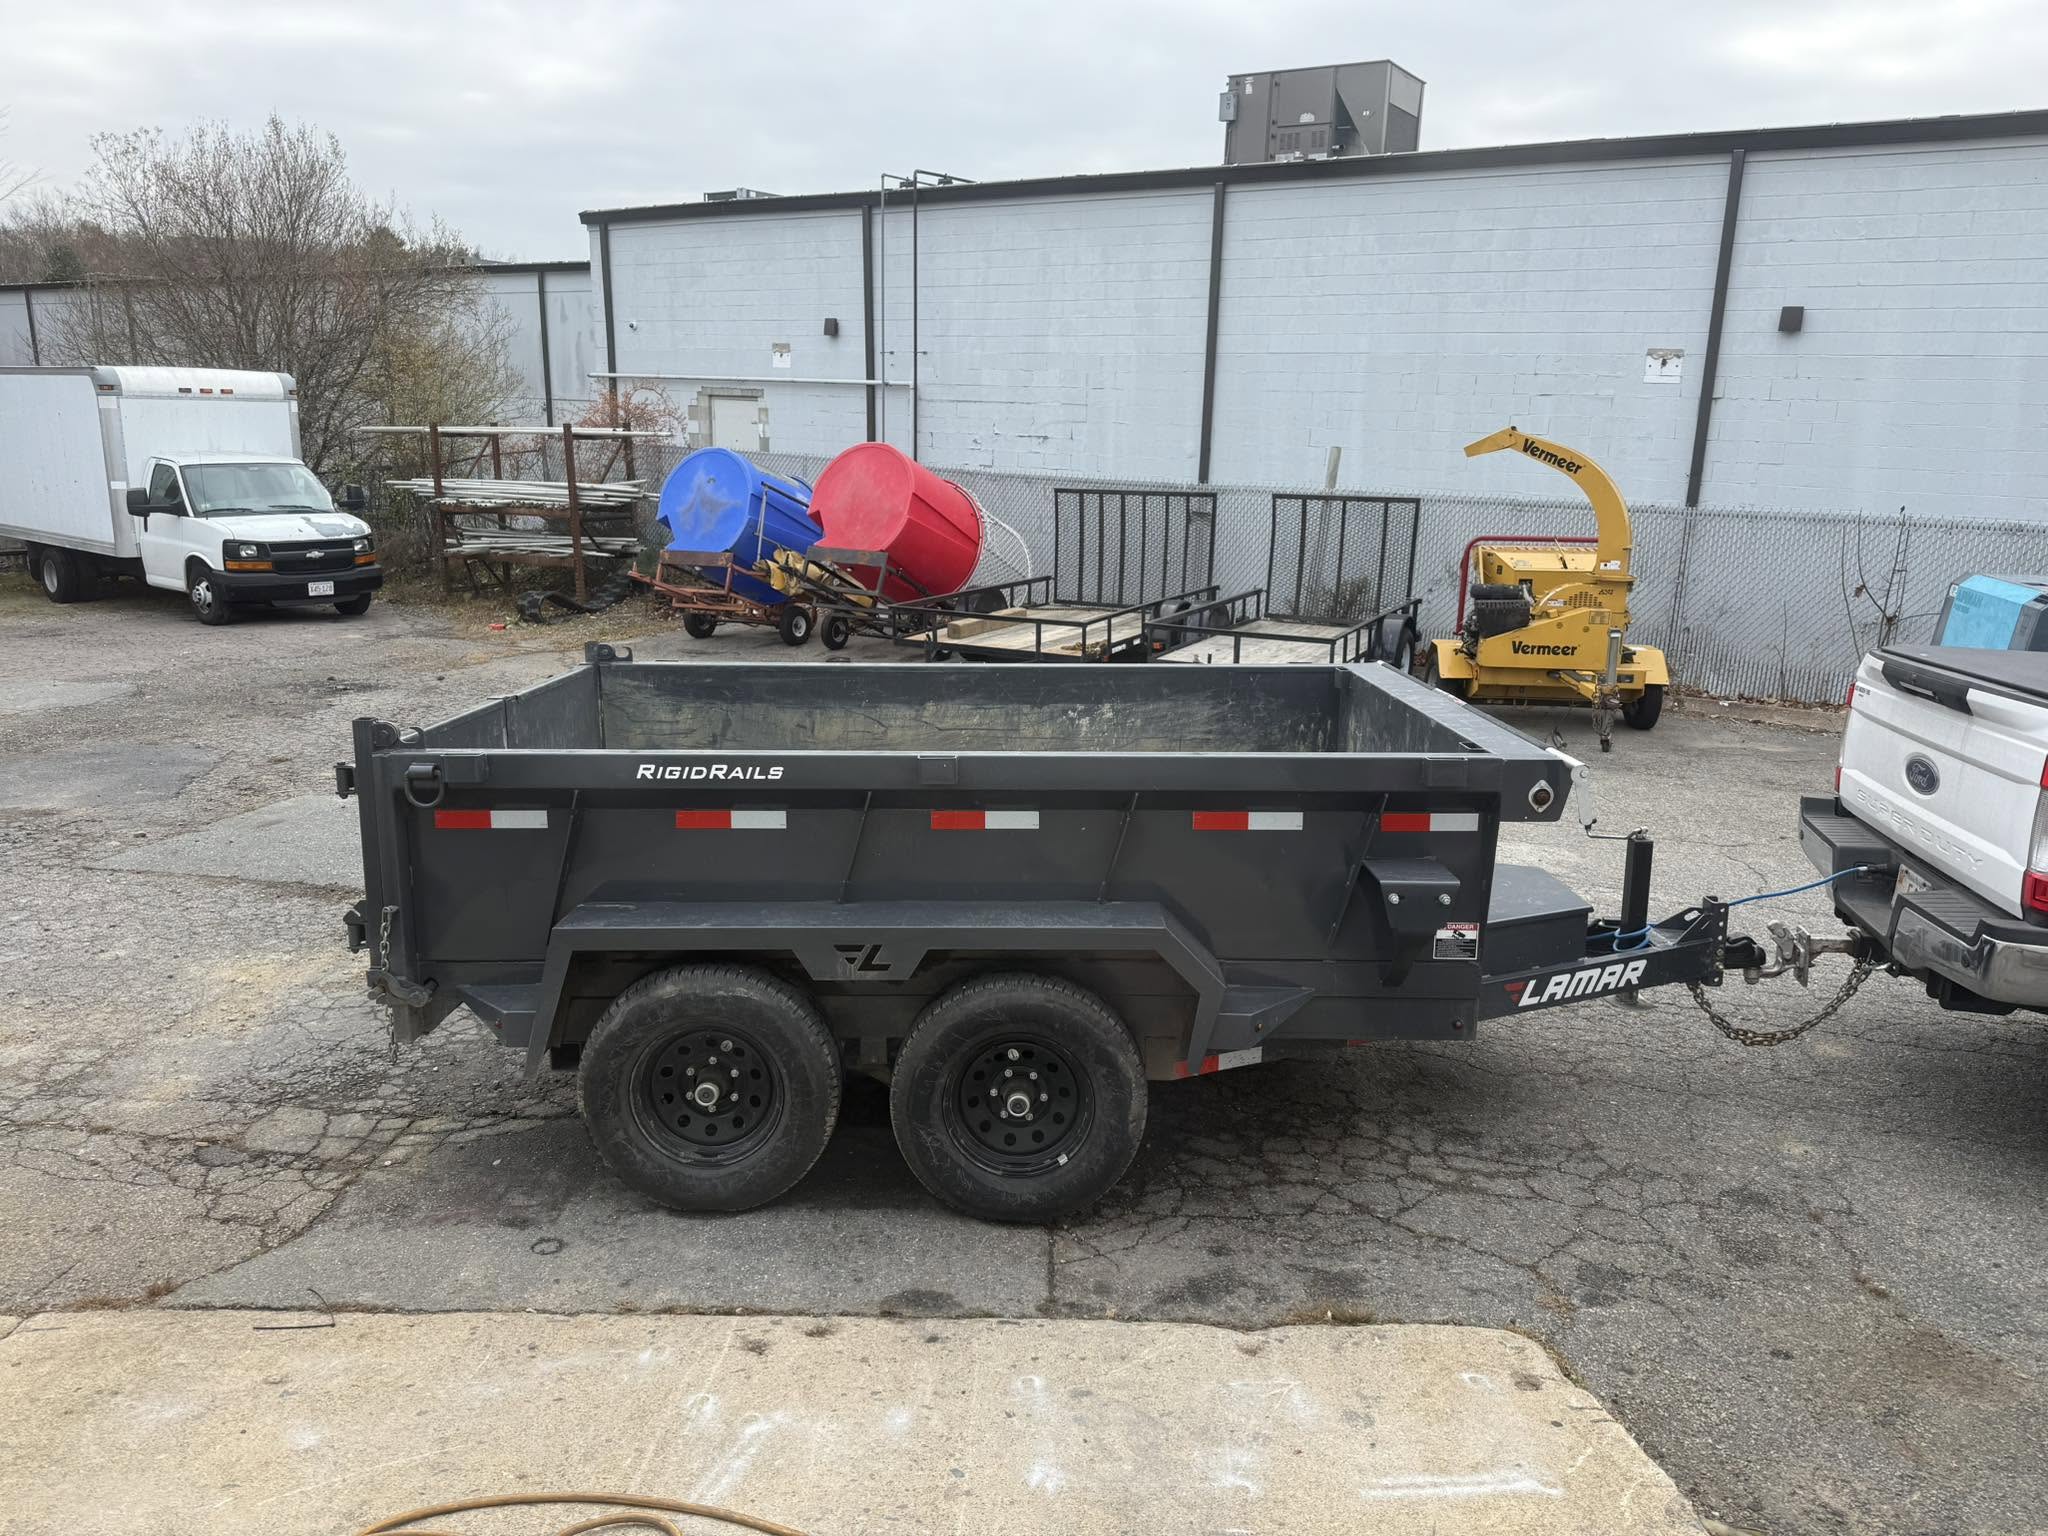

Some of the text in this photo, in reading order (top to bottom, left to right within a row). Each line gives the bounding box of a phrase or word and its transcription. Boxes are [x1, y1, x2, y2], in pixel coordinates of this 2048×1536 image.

[1522, 438, 1583, 474] Vermeer
[1511, 640, 1578, 656] Vermeer
[1856, 788, 1984, 872] SUPER DUTY
[1518, 959, 1648, 1007] LAMAR
